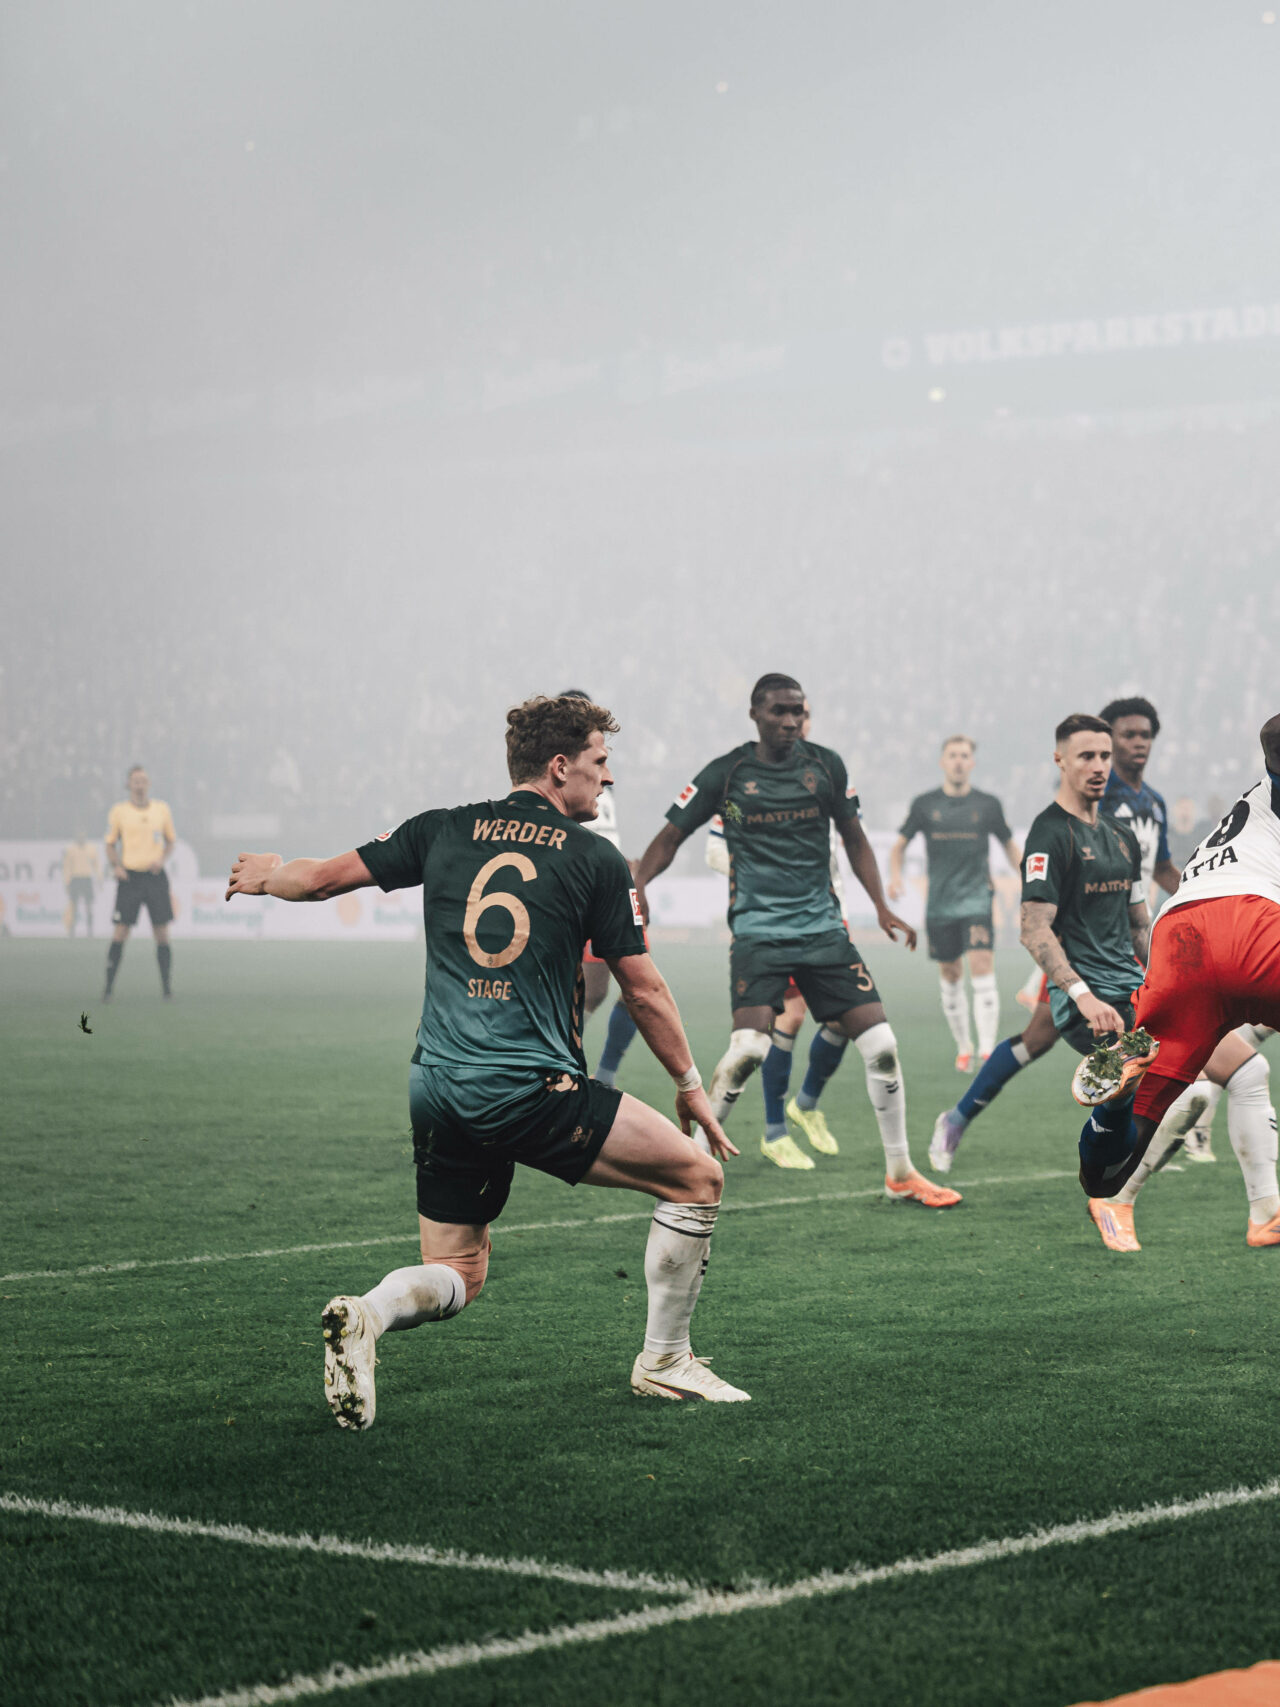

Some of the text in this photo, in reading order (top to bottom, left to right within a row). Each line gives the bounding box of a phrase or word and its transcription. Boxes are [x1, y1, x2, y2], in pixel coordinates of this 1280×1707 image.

[472, 817, 568, 851] WERDER
[463, 851, 538, 969] 6
[467, 978, 513, 1001] STAGE
